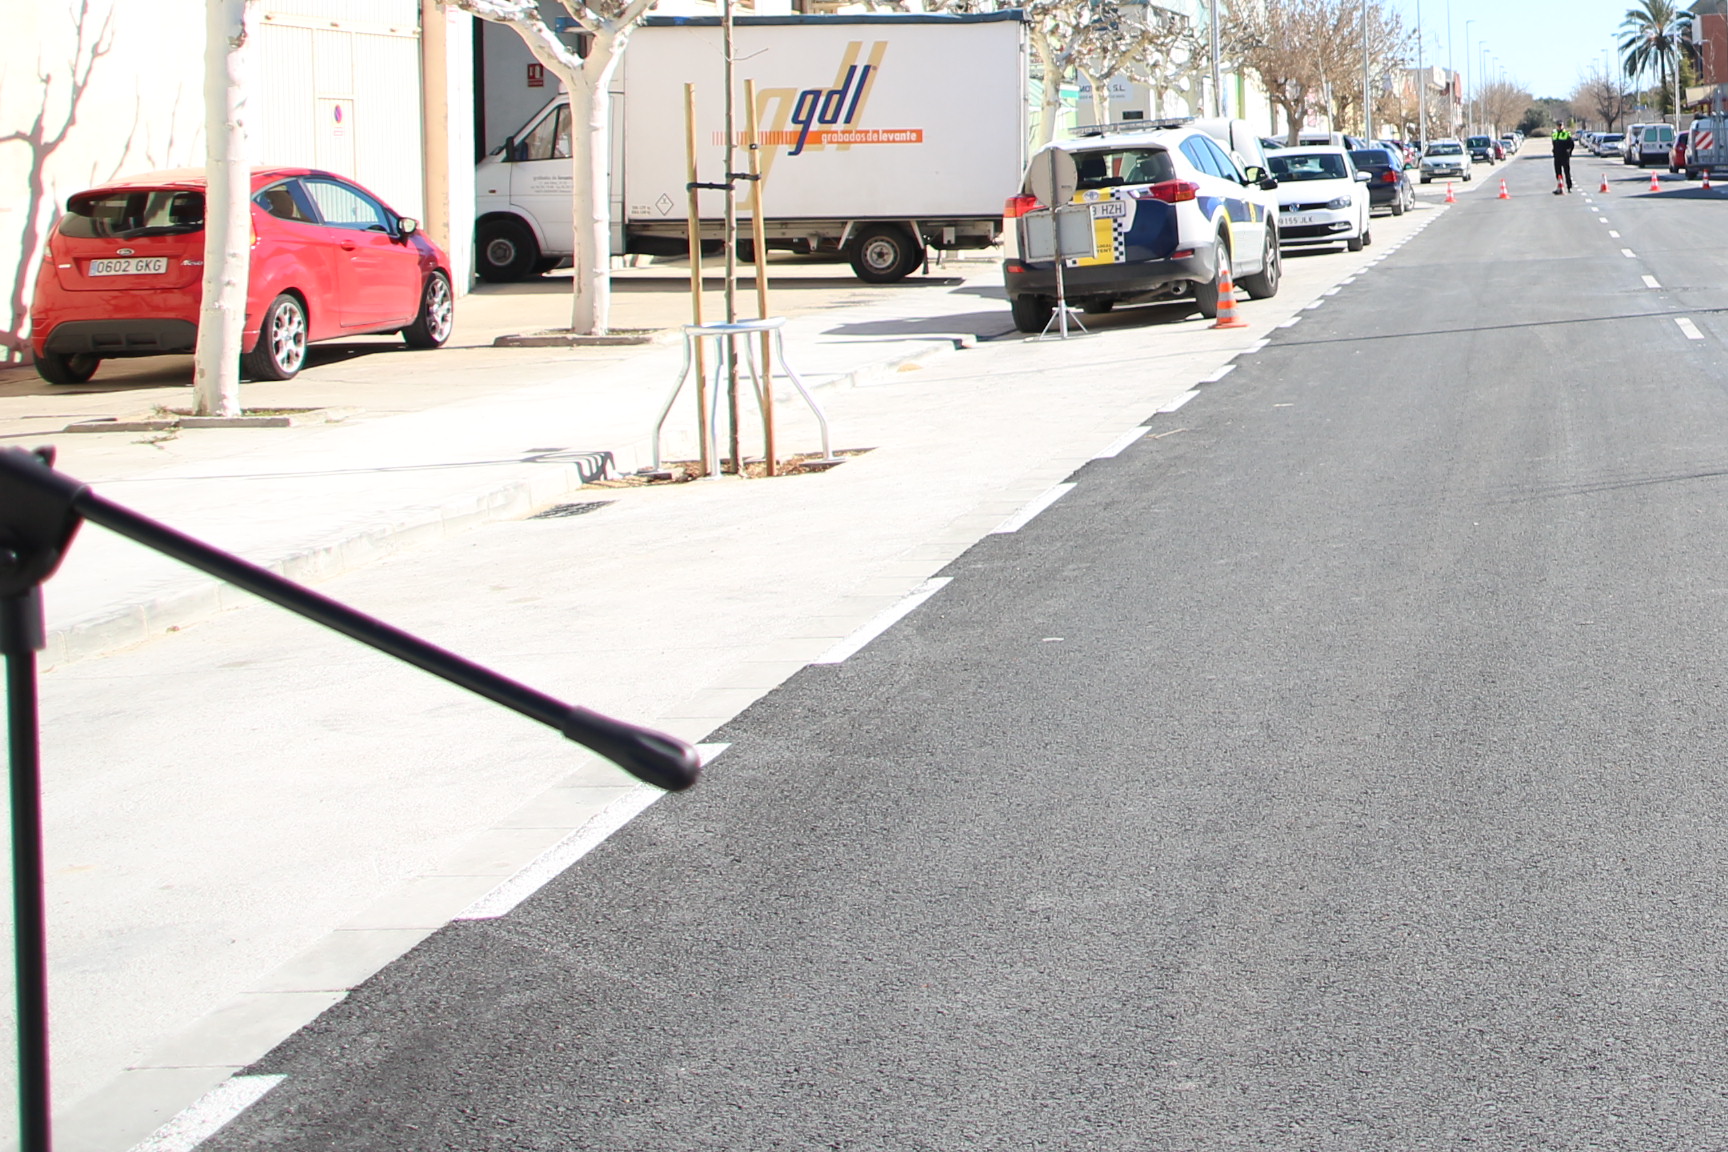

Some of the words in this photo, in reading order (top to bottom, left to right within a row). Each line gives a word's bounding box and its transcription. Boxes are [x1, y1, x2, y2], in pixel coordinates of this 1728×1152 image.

[788, 65, 872, 156] gdl
[1101, 204, 1122, 215] HZH
[96, 261, 130, 273] 0602
[136, 260, 162, 272] GKG
